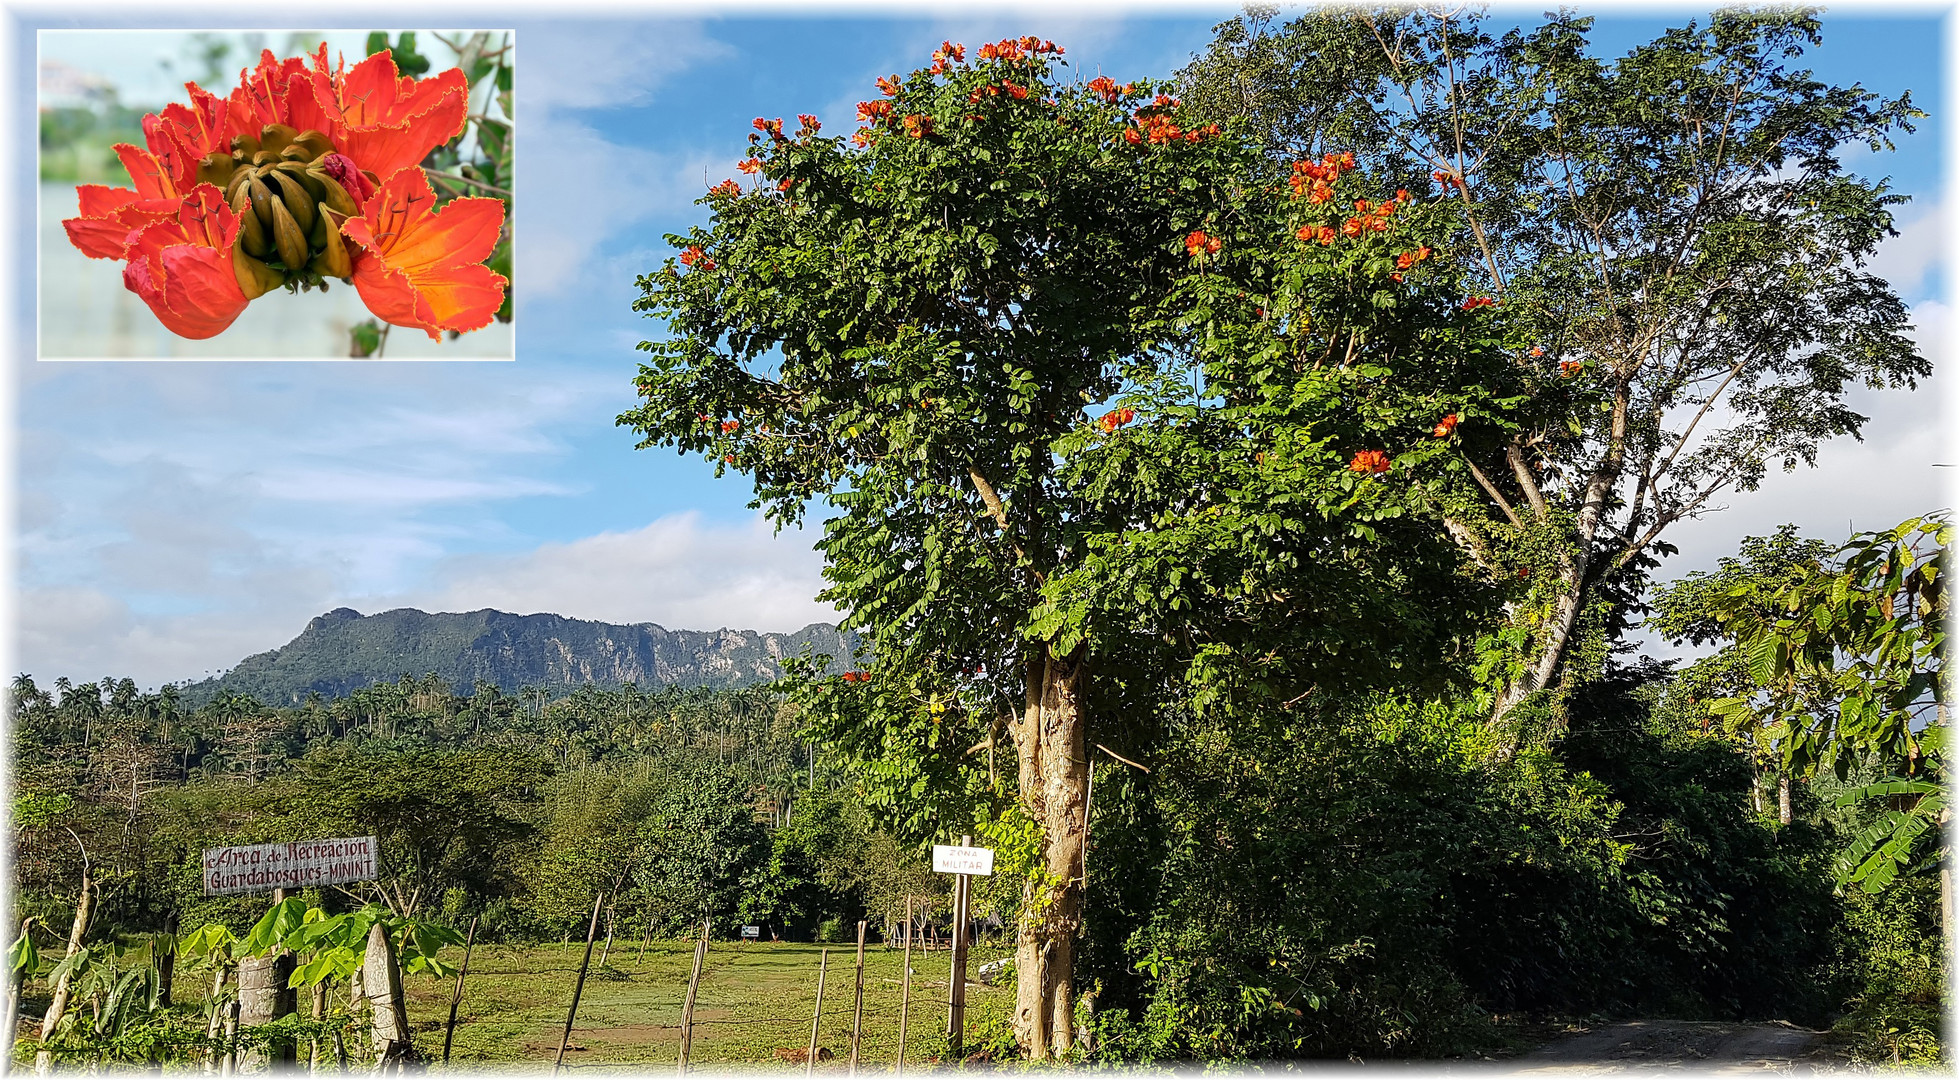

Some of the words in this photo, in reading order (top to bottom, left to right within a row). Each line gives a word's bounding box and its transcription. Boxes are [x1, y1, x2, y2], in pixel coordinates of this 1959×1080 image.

[949, 849, 978, 857] ZONA
[207, 848, 260, 869] Area
[267, 851, 282, 863] de
[942, 860, 983, 870] MILITAR
